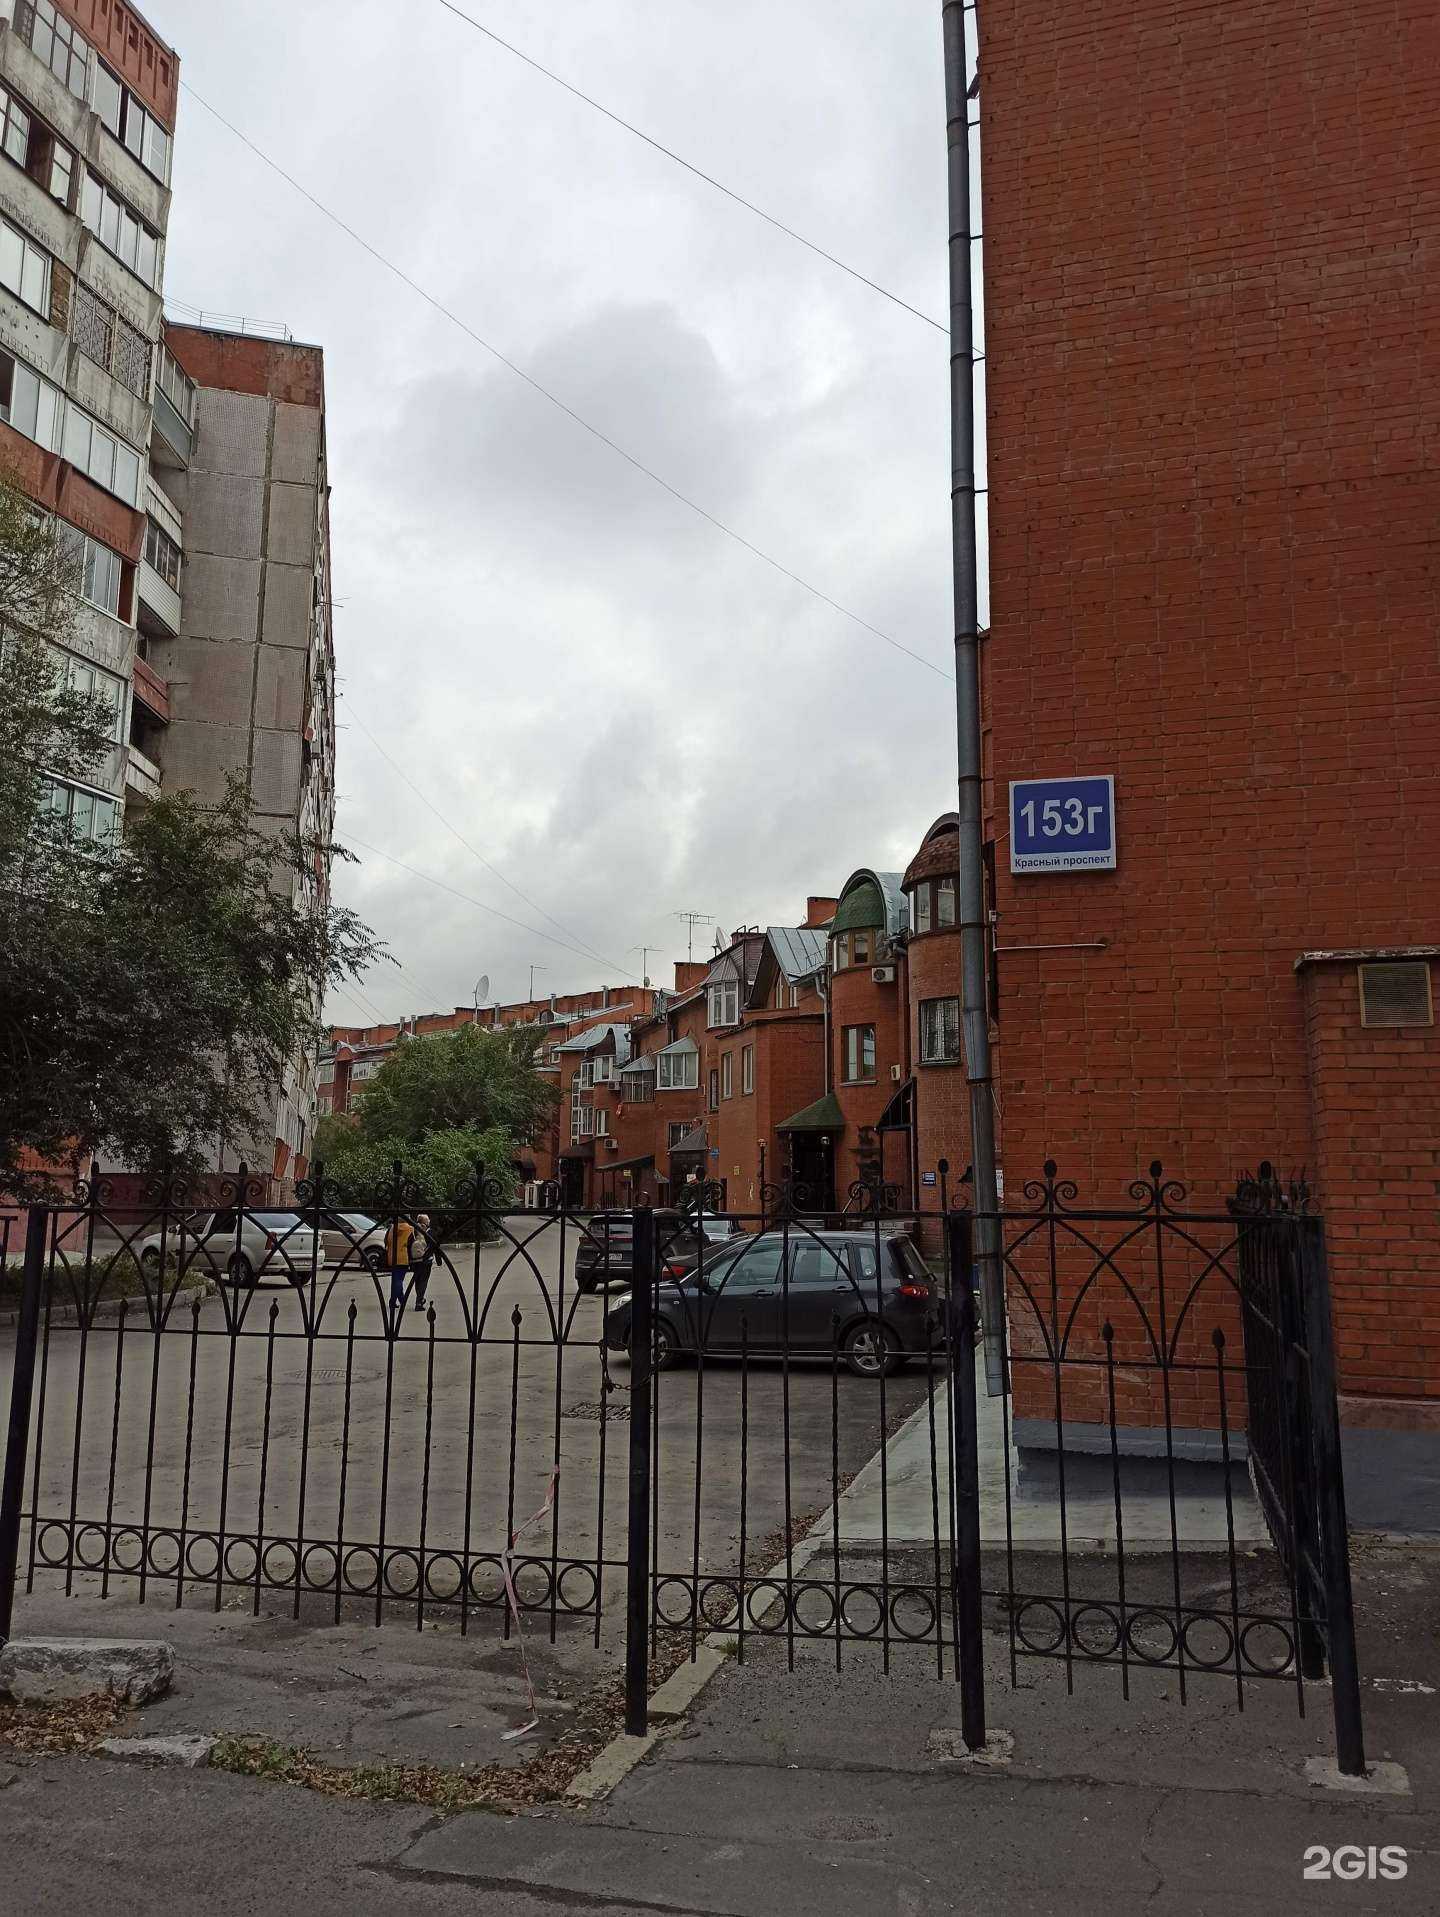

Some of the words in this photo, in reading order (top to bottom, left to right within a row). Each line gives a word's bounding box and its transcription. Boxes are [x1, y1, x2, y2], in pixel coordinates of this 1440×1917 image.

[1020, 798, 1103, 837] 153г
[1015, 857, 1060, 869] Красный
[1063, 855, 1111, 867] проспект
